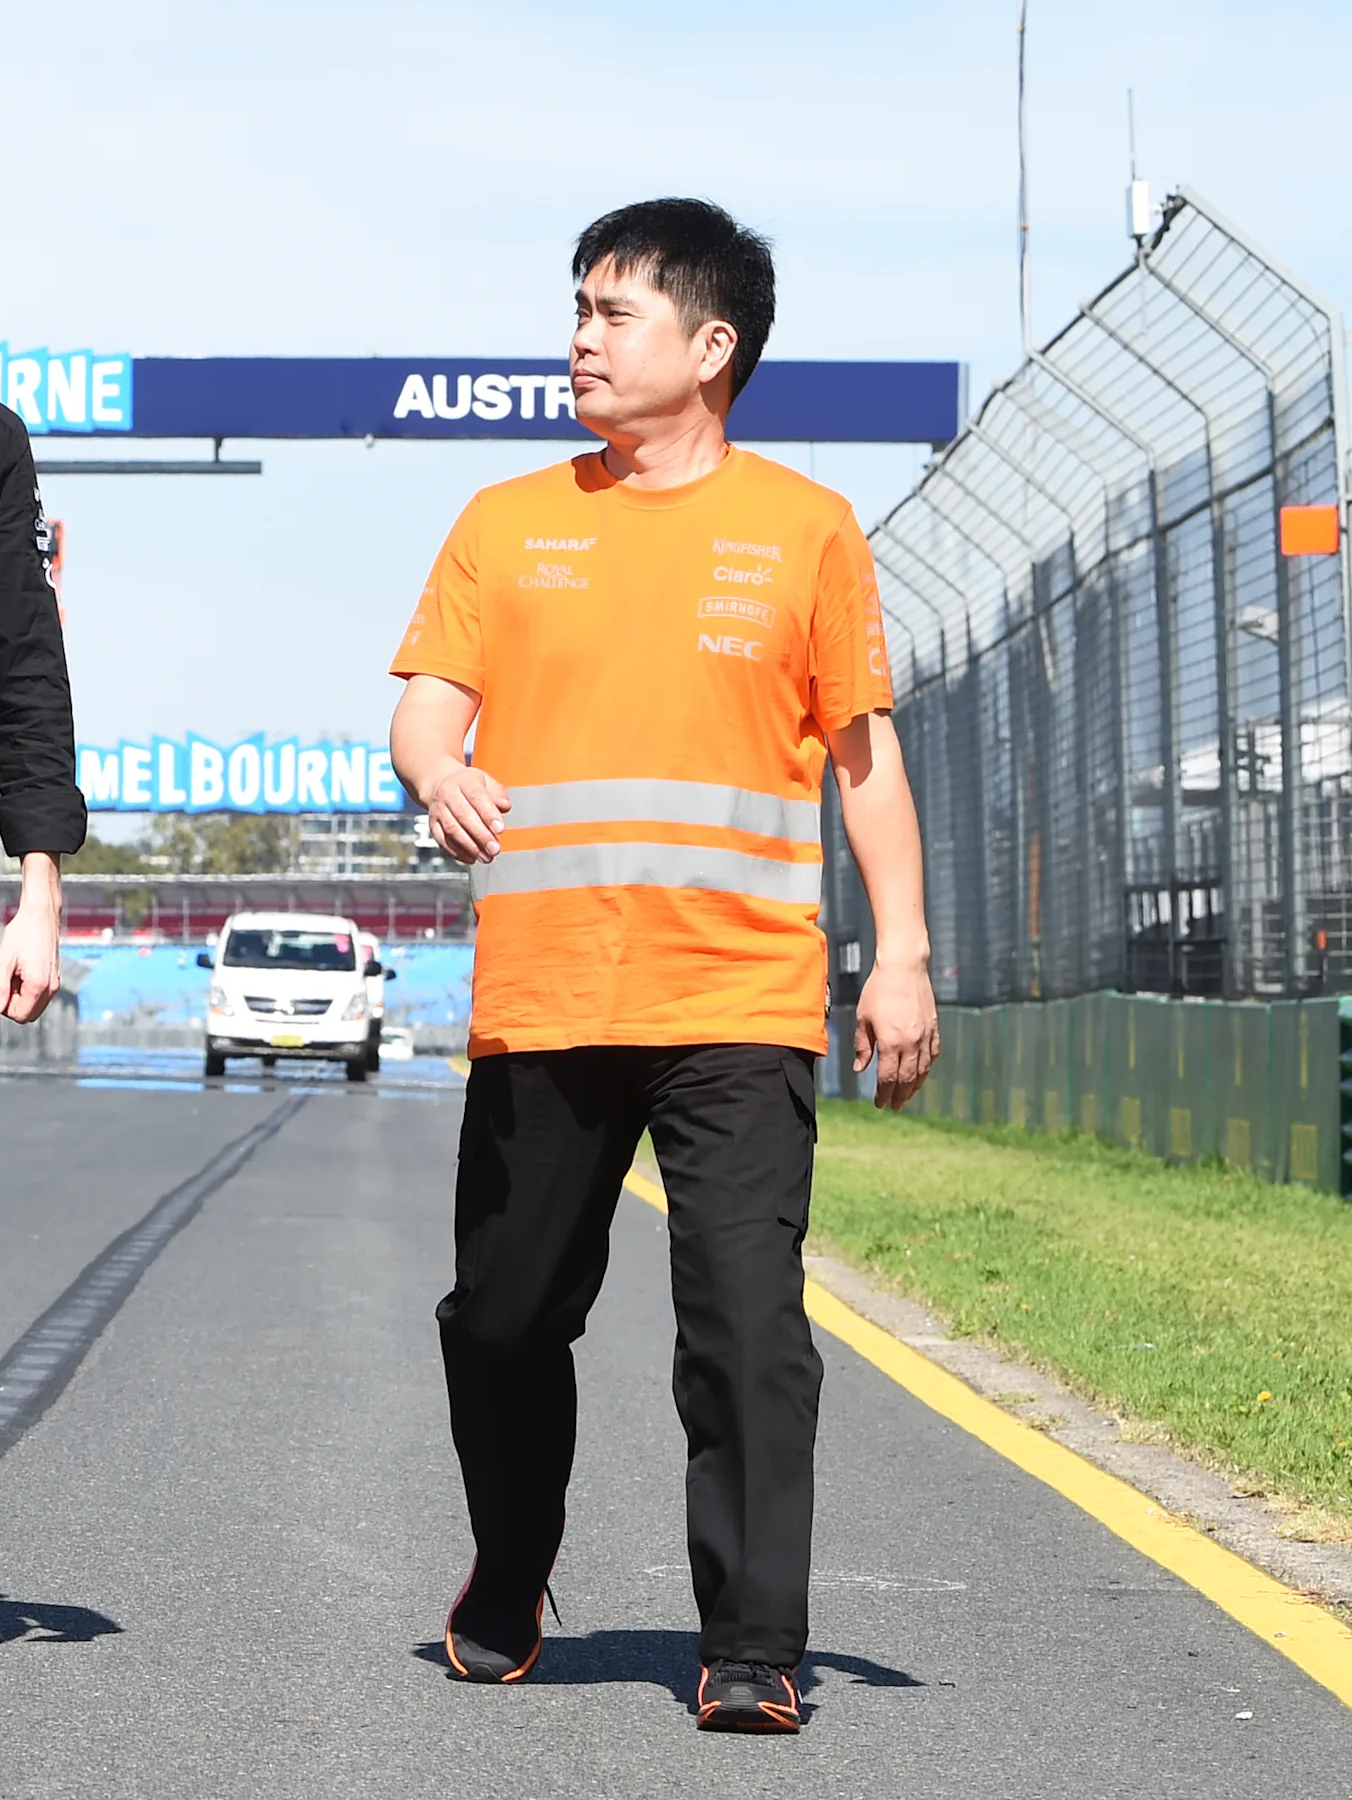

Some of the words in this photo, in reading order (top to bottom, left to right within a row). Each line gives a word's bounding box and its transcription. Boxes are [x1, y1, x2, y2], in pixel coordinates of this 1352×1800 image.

[393, 374, 577, 420] AUSTR
[524, 538, 590, 551] SAHARA
[712, 538, 782, 563] KINGFISHER
[537, 562, 573, 576] ROYAL
[713, 565, 765, 586] Claro
[706, 601, 769, 623] SMIRNOFF
[697, 633, 764, 661] NEC
[80, 740, 398, 806] MELBOURNE
